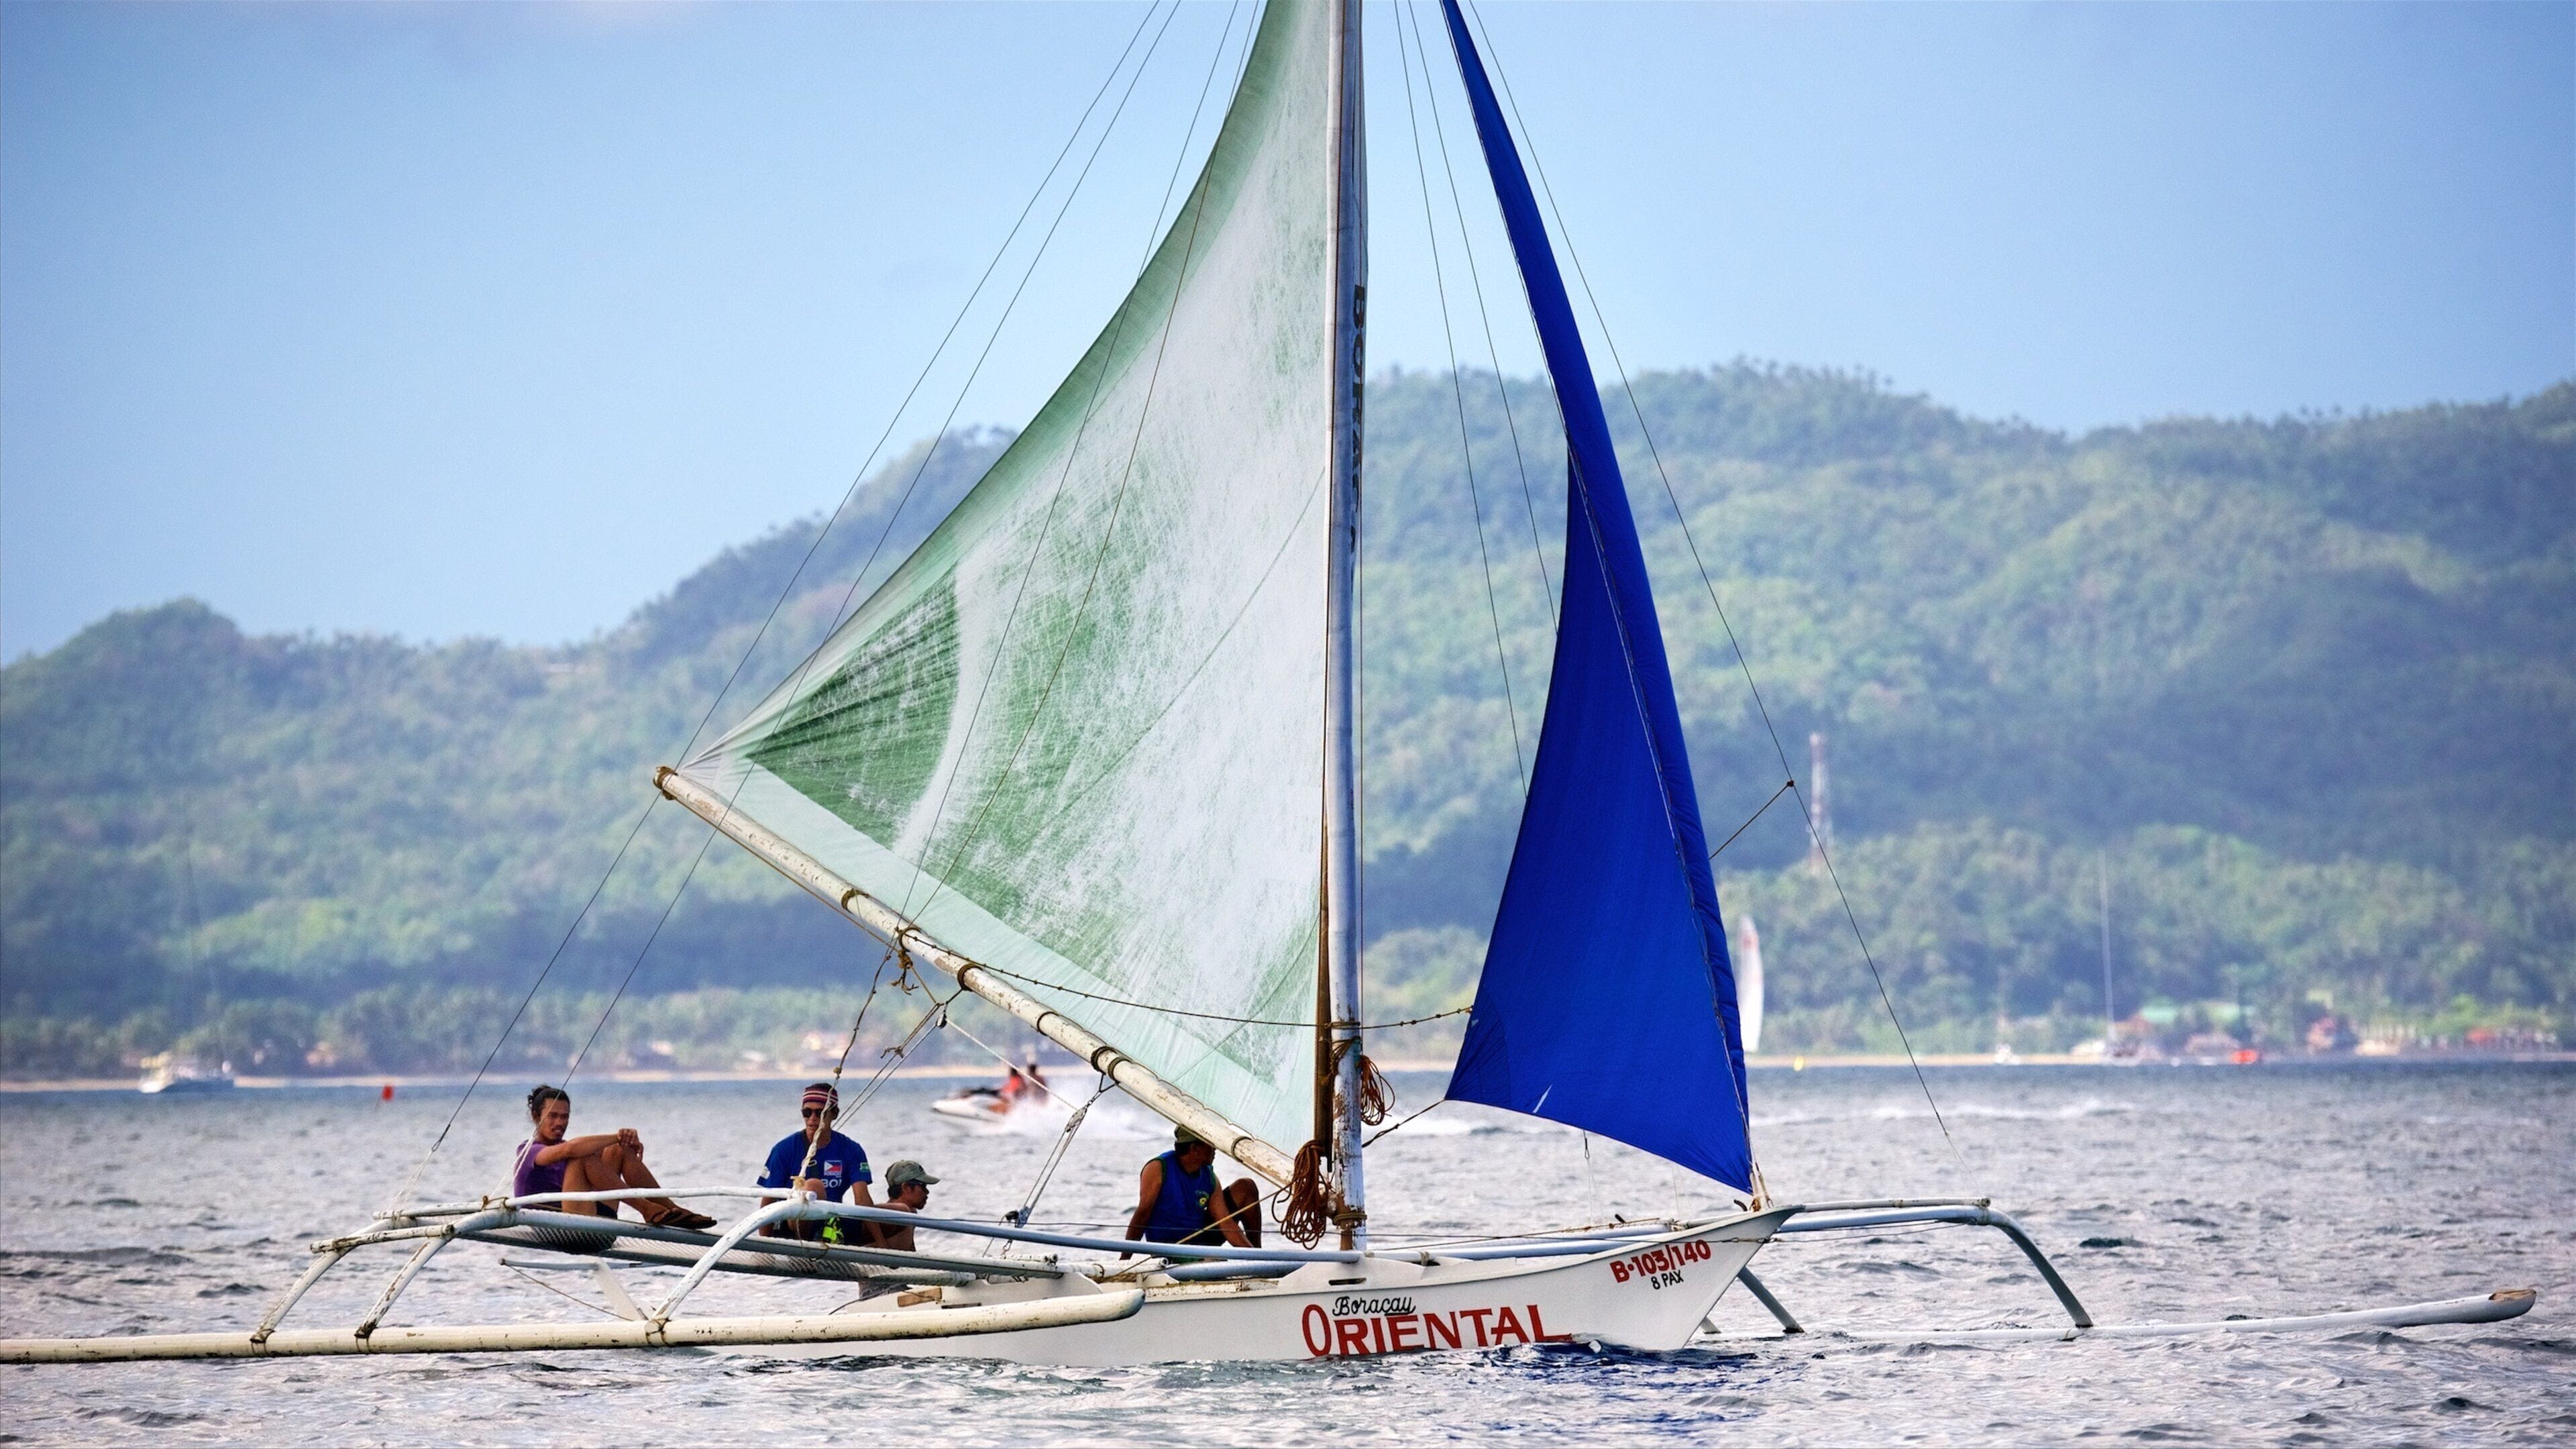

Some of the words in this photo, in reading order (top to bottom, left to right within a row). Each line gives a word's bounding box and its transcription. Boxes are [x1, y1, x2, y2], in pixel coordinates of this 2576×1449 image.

[1650, 1276, 1660, 1289] 8
[1661, 1270, 1684, 1287] PAX
[1332, 1295, 1416, 1316] Boracay
[1302, 1304, 1572, 1357] ORIENTAL
